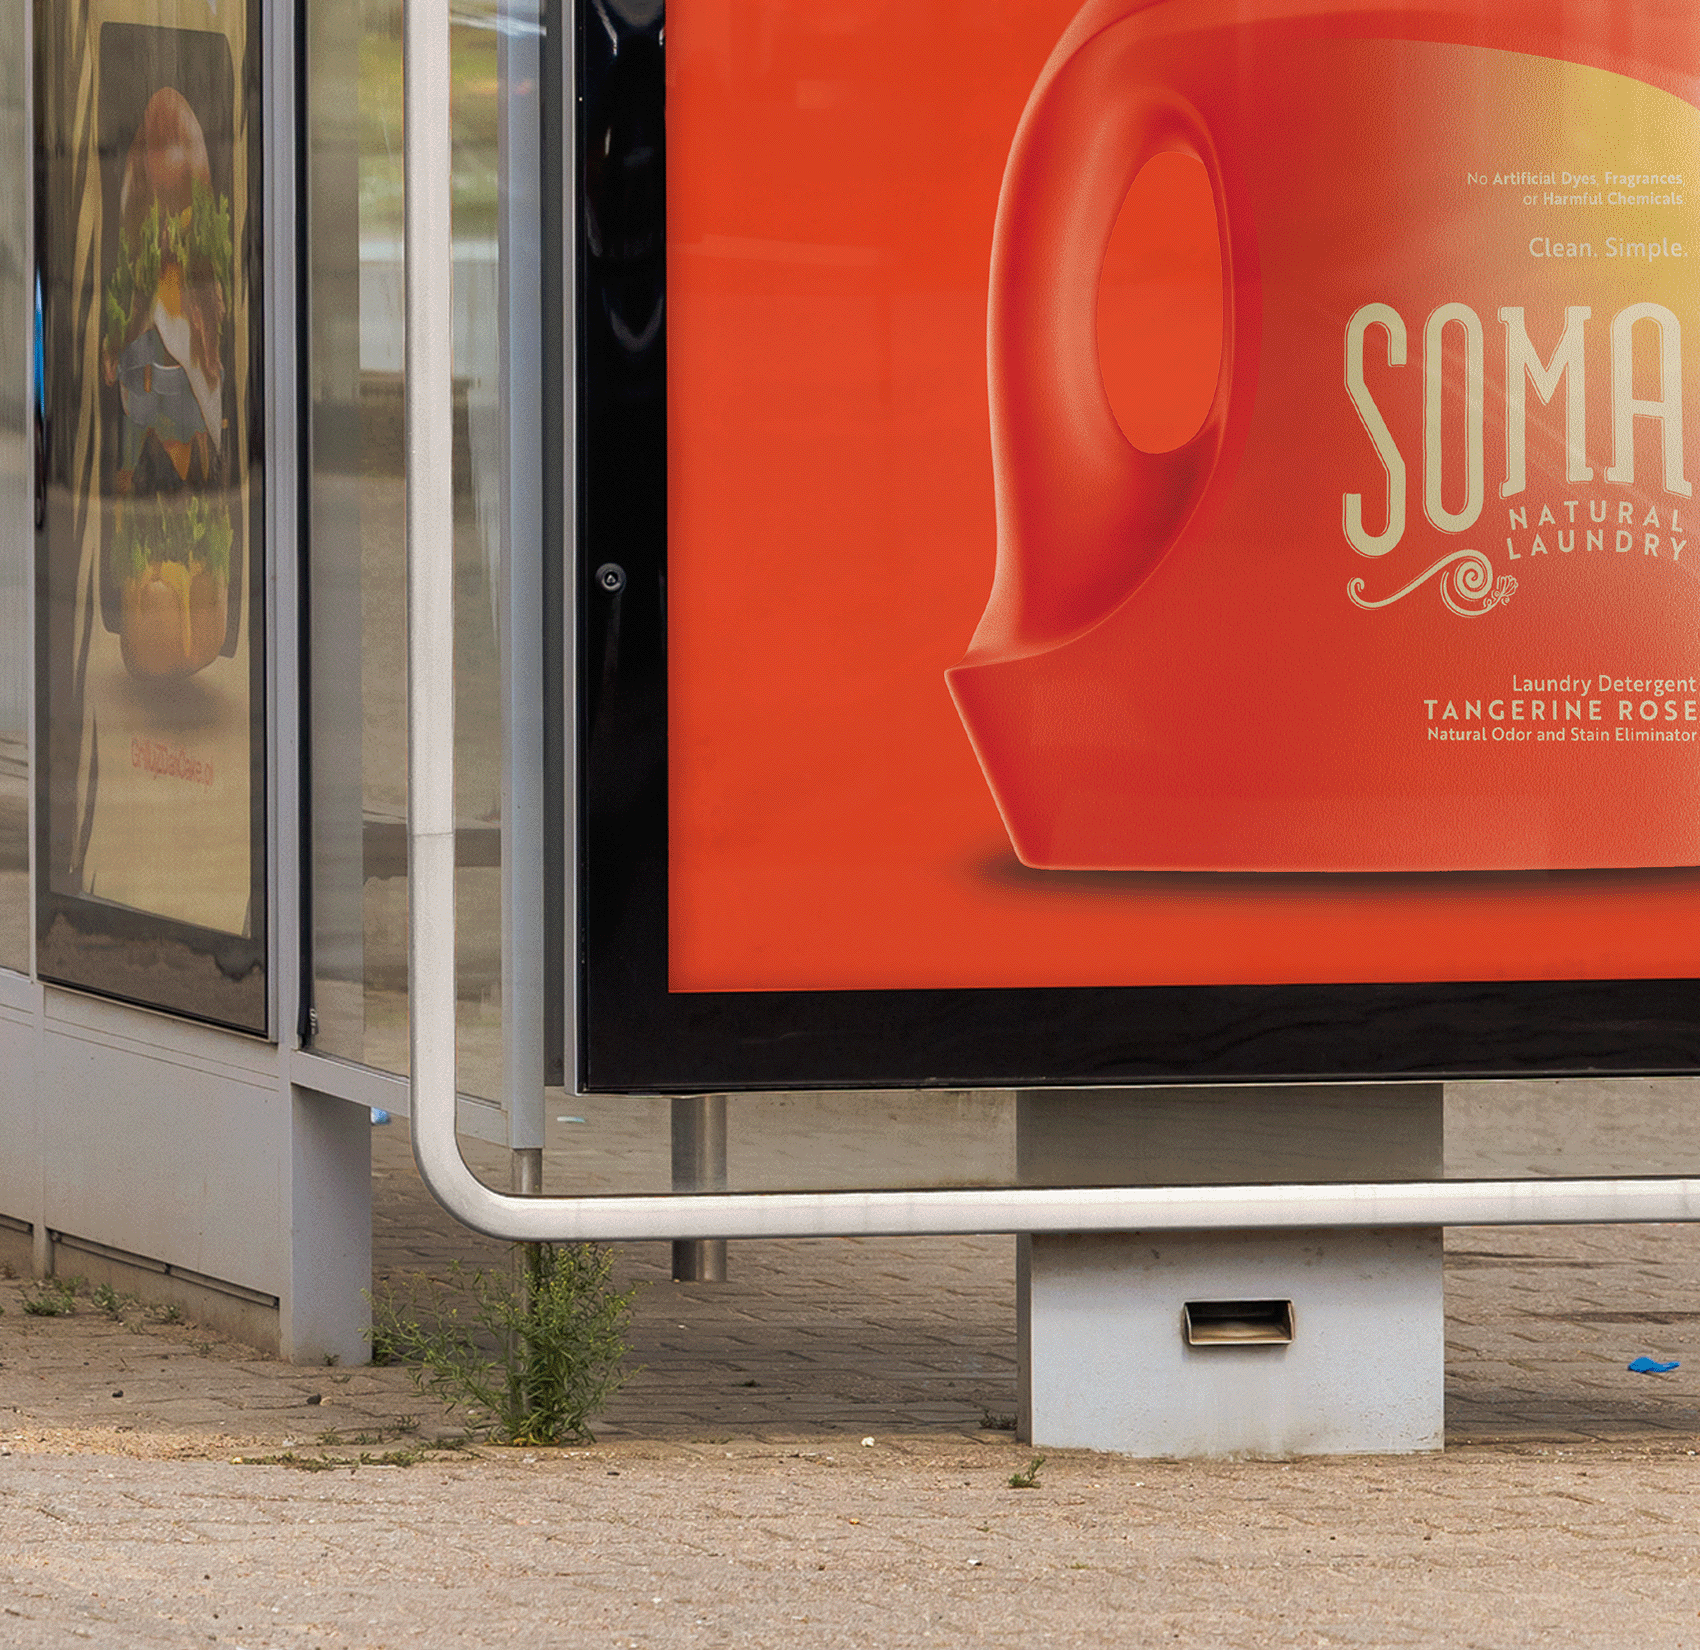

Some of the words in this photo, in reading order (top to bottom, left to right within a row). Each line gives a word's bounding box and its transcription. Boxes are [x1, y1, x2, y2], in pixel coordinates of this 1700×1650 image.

[1467, 172, 1488, 185] No
[1493, 172, 1557, 185] Artificial
[1561, 172, 1600, 189] Dyes,
[1605, 172, 1686, 188] Fragrances,
[1523, 195, 1538, 206] or
[1543, 192, 1602, 206] Harmful
[1528, 237, 1598, 258] Clean.
[1605, 236, 1689, 262] Simple.
[1343, 302, 1693, 559] SOMA
[1508, 500, 1684, 534] NATURAL
[1506, 529, 1688, 562] LAUNDRY
[1513, 674, 1592, 696] Laundry
[1598, 674, 1697, 697] Detergent
[1423, 699, 1603, 721] TANGERINE
[1618, 699, 1698, 721] ROSE
[1427, 726, 1487, 742] Natural
[1491, 726, 1533, 742] Odor
[1536, 727, 1566, 741] and
[1570, 727, 1610, 741] Stain
[1614, 727, 1698, 742] Eliminator
